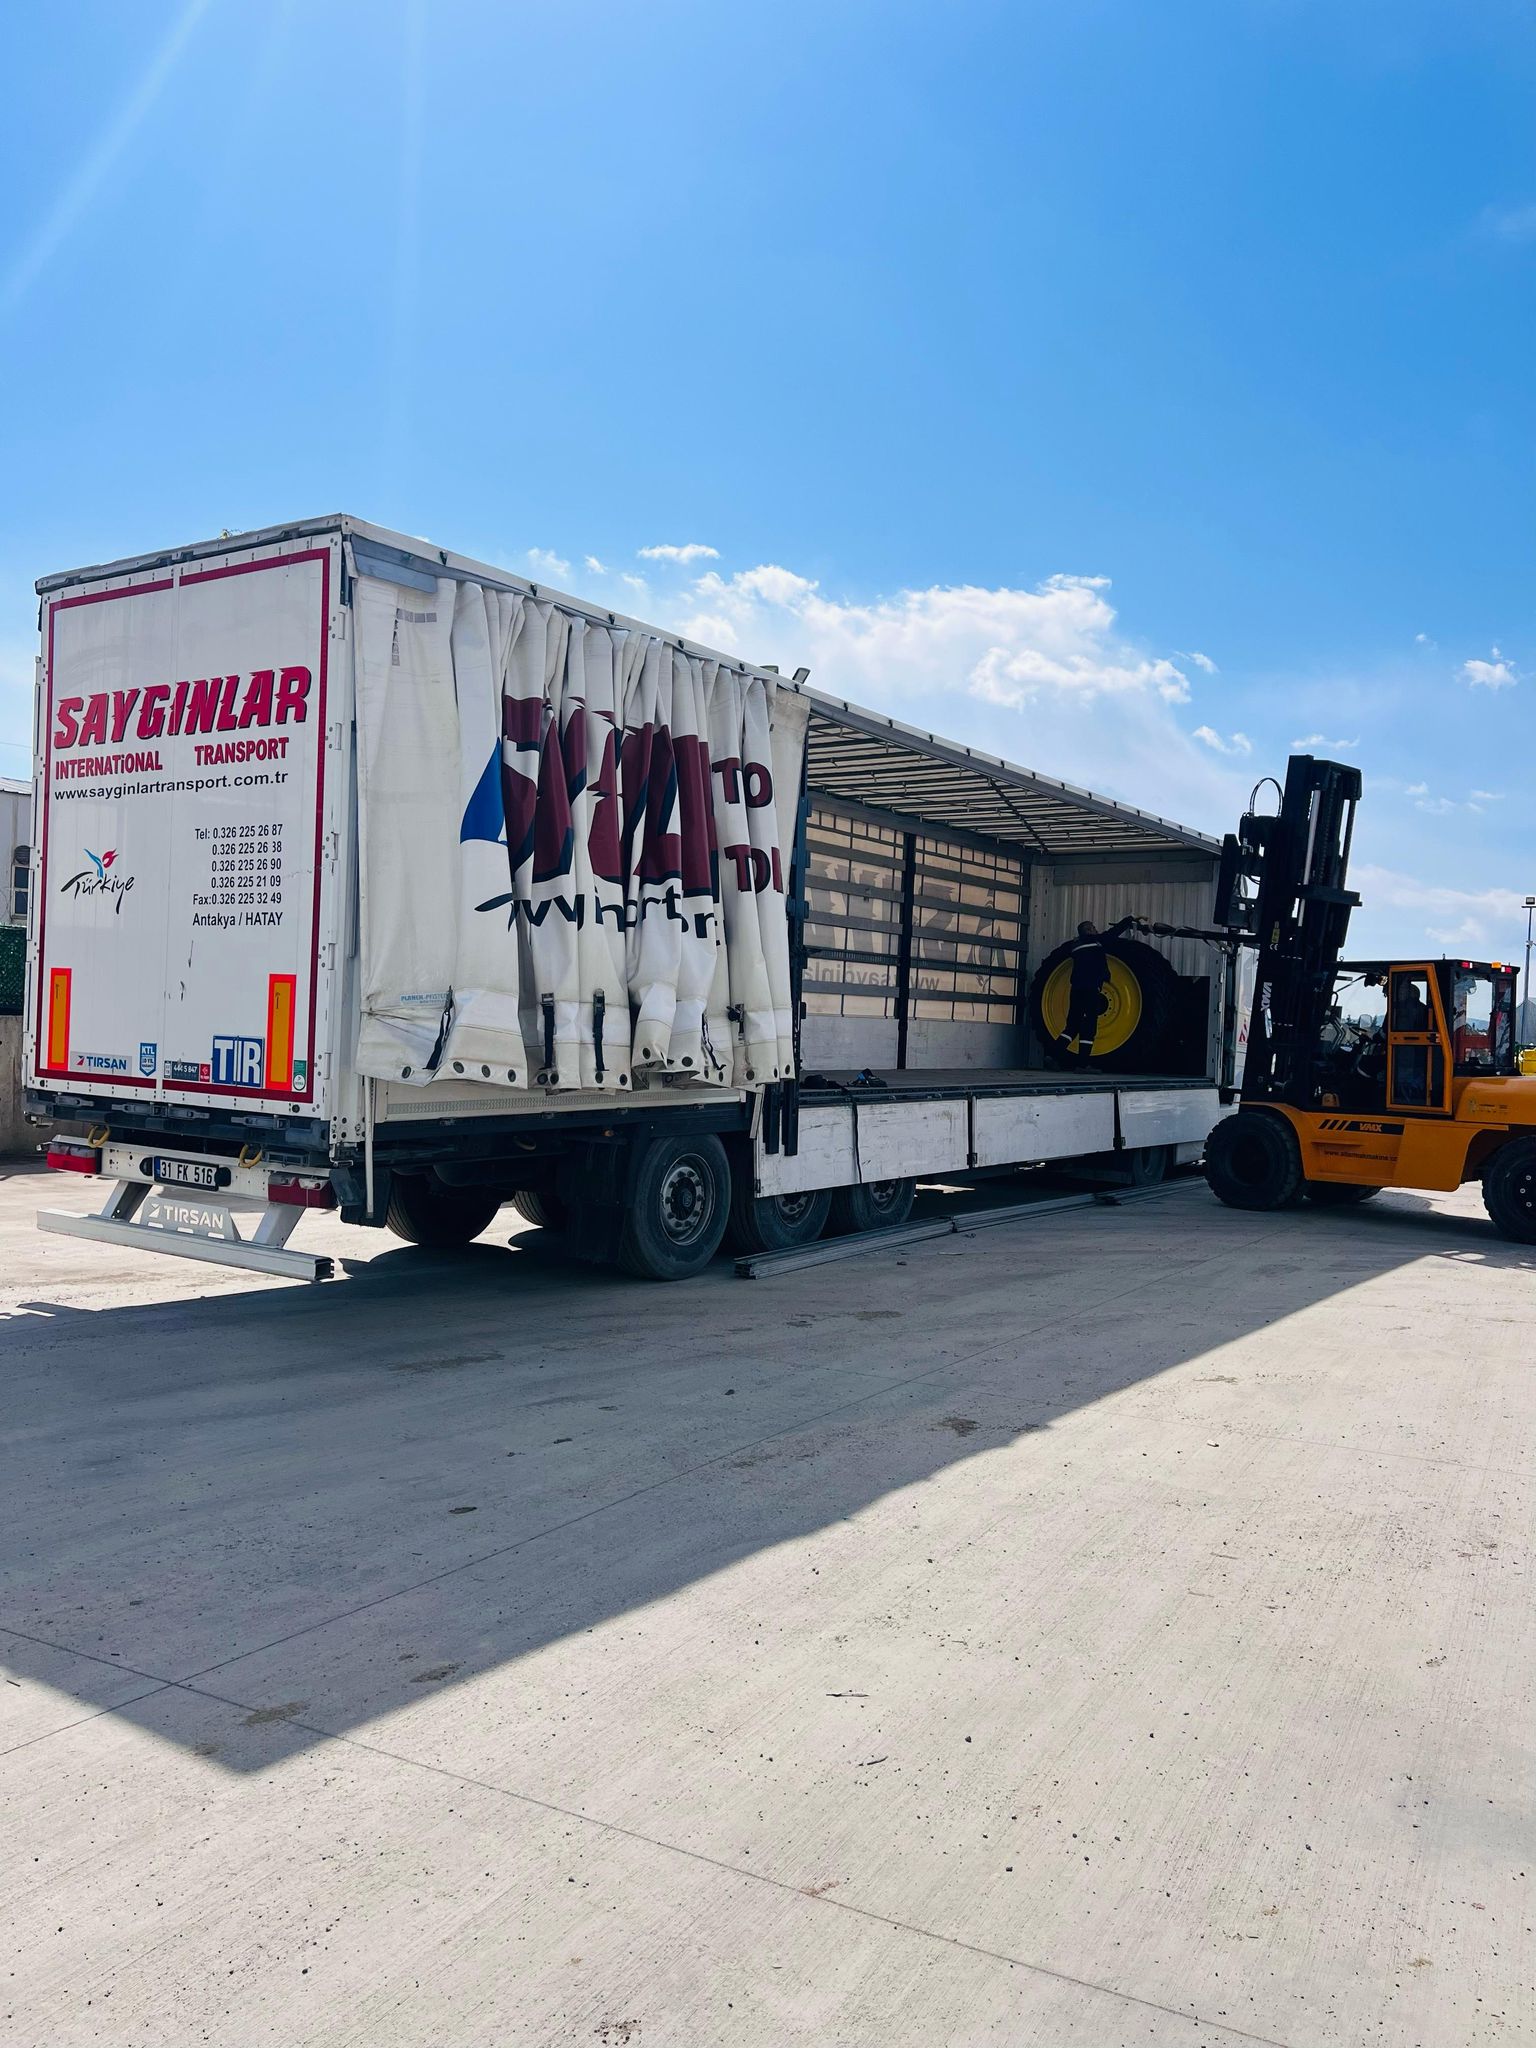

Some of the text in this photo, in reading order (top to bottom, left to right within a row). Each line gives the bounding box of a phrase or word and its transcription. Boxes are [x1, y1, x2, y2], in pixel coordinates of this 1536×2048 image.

[54, 666, 311, 749] SAYGINLAR
[194, 736, 290, 767] TRANSPORT
[54, 770, 289, 800] www.sayginlartransport.com.tr
[195, 823, 283, 840] Tel: 0.326 225 26 87
[212, 843, 236, 856] 0.326
[238, 842, 255, 855] 225
[257, 841, 269, 854] 26
[211, 857, 282, 872] 0.326 225 26 90
[211, 874, 281, 889] 0.326 225 21 09
[60, 871, 135, 915] Türkiye
[238, 892, 255, 905] 225
[256, 892, 268, 904] 32
[270, 891, 282, 904] 49
[192, 911, 236, 930] Antakya
[245, 911, 283, 926] HATAY
[142, 1046, 154, 1054] KTL
[86, 1056, 127, 1071] TIRSAN
[214, 1039, 261, 1084] TIR
[161, 1162, 213, 1184] 31 FK 516
[163, 1205, 224, 1230] TIRSAN
